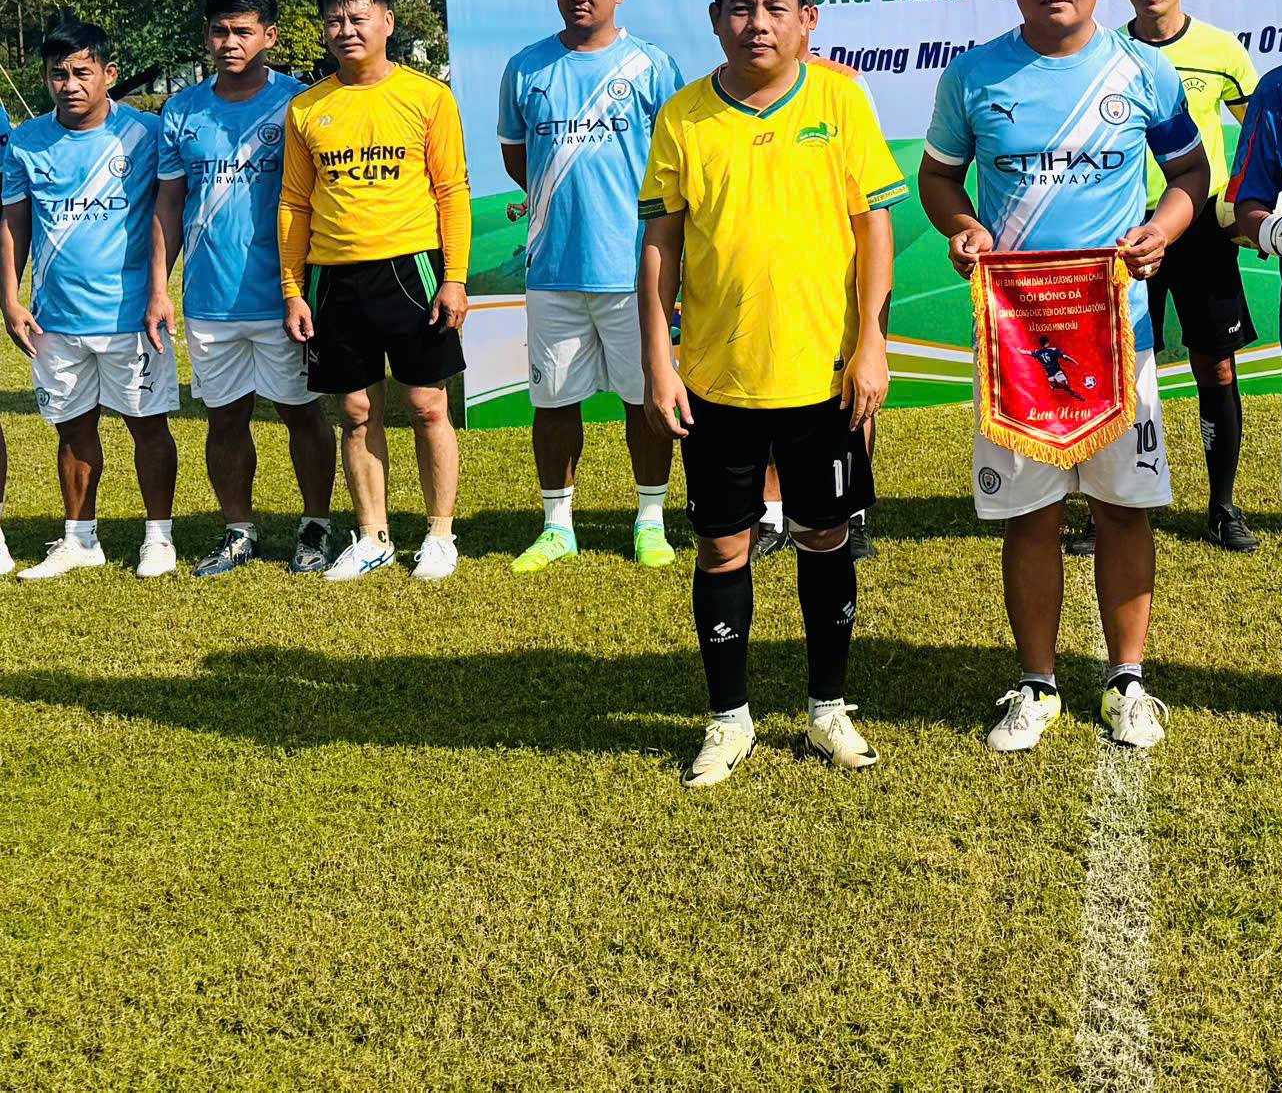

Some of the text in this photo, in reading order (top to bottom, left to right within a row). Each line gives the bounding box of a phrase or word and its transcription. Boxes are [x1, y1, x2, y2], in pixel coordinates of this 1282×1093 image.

[830, 47, 909, 74] Dương
[536, 117, 629, 136] ETIHAD
[552, 134, 613, 147] AIRWAYS
[319, 145, 406, 167] NHÀ HÀNG
[994, 151, 1124, 173] ETIHAD
[191, 159, 278, 174] ETIHAD
[346, 165, 400, 185] CỤM
[201, 175, 261, 185] AIRWAYS
[1018, 174, 1102, 186] AIRWAYS
[39, 196, 129, 212] ETIHAD
[138, 352, 151, 378] 2
[1134, 418, 1157, 455] 10
